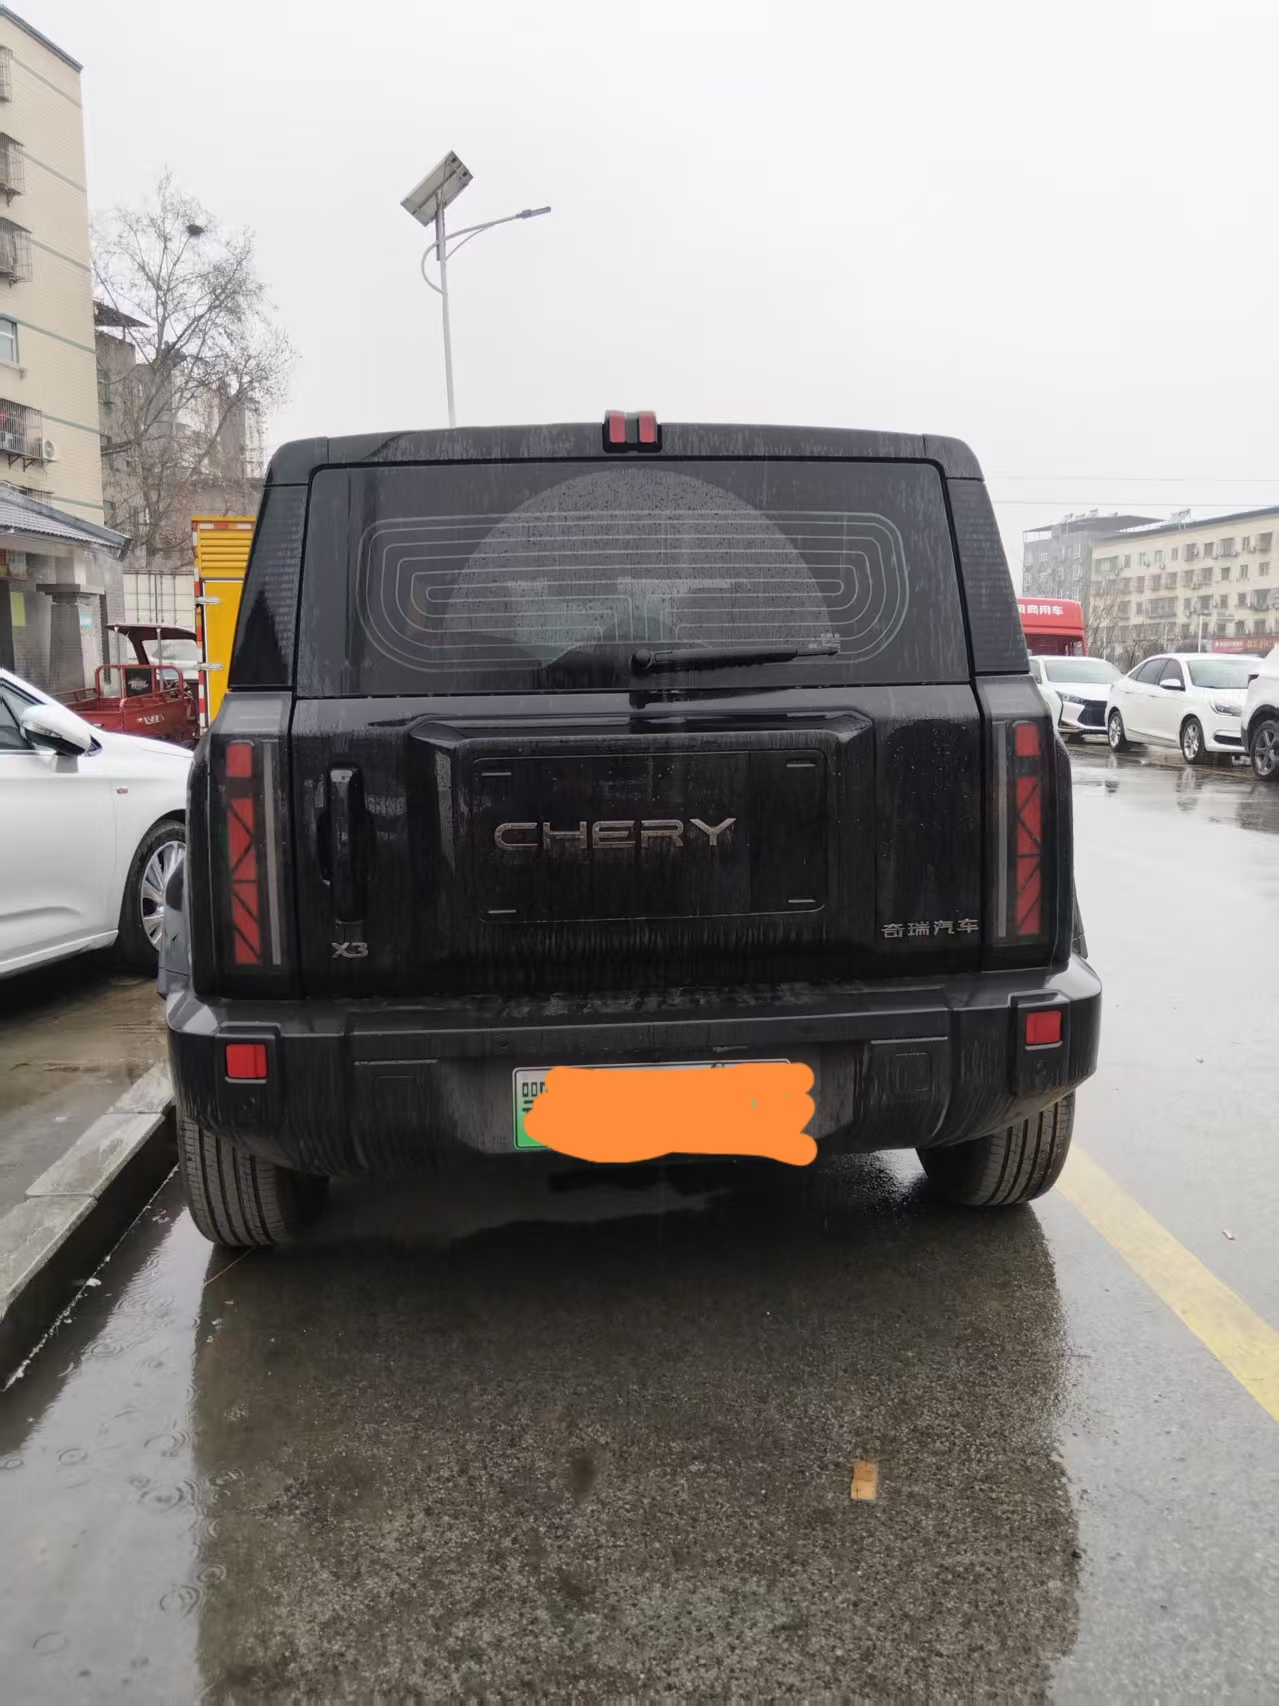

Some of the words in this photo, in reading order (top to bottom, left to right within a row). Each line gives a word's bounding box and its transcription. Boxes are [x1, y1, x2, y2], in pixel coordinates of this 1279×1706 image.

[494, 817, 736, 850] CHERY
[881, 918, 979, 938] 奇瑞汽车
[330, 942, 369, 958] X3
